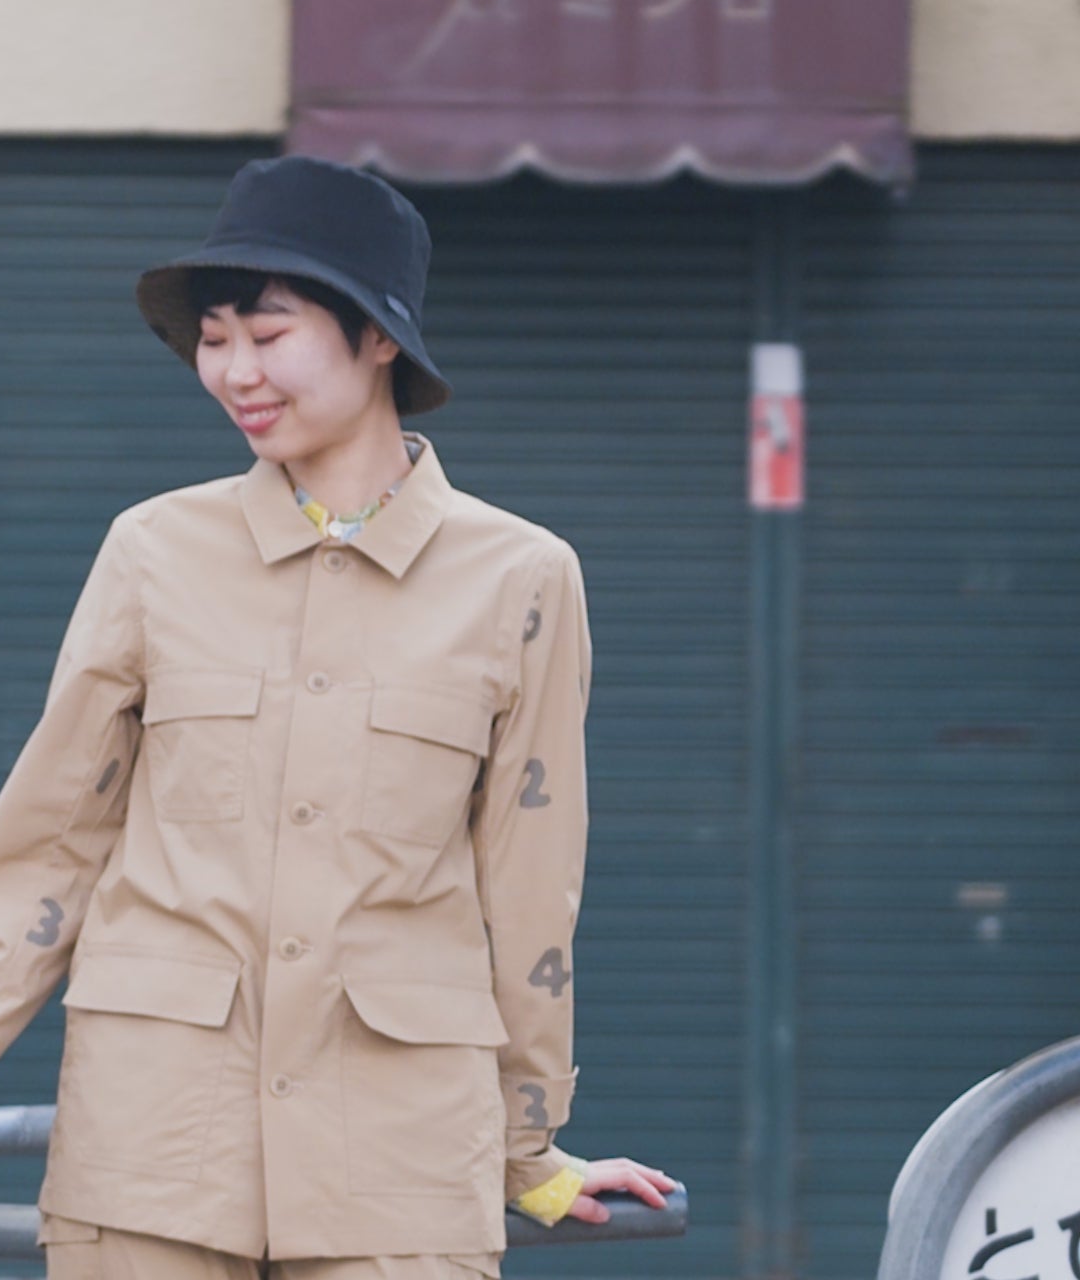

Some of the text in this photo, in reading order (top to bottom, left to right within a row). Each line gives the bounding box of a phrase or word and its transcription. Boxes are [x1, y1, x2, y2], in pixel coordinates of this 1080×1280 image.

[518, 757, 552, 809] 2
[25, 896, 66, 948] 3
[527, 946, 572, 999] 4
[517, 1082, 549, 1130] 3
